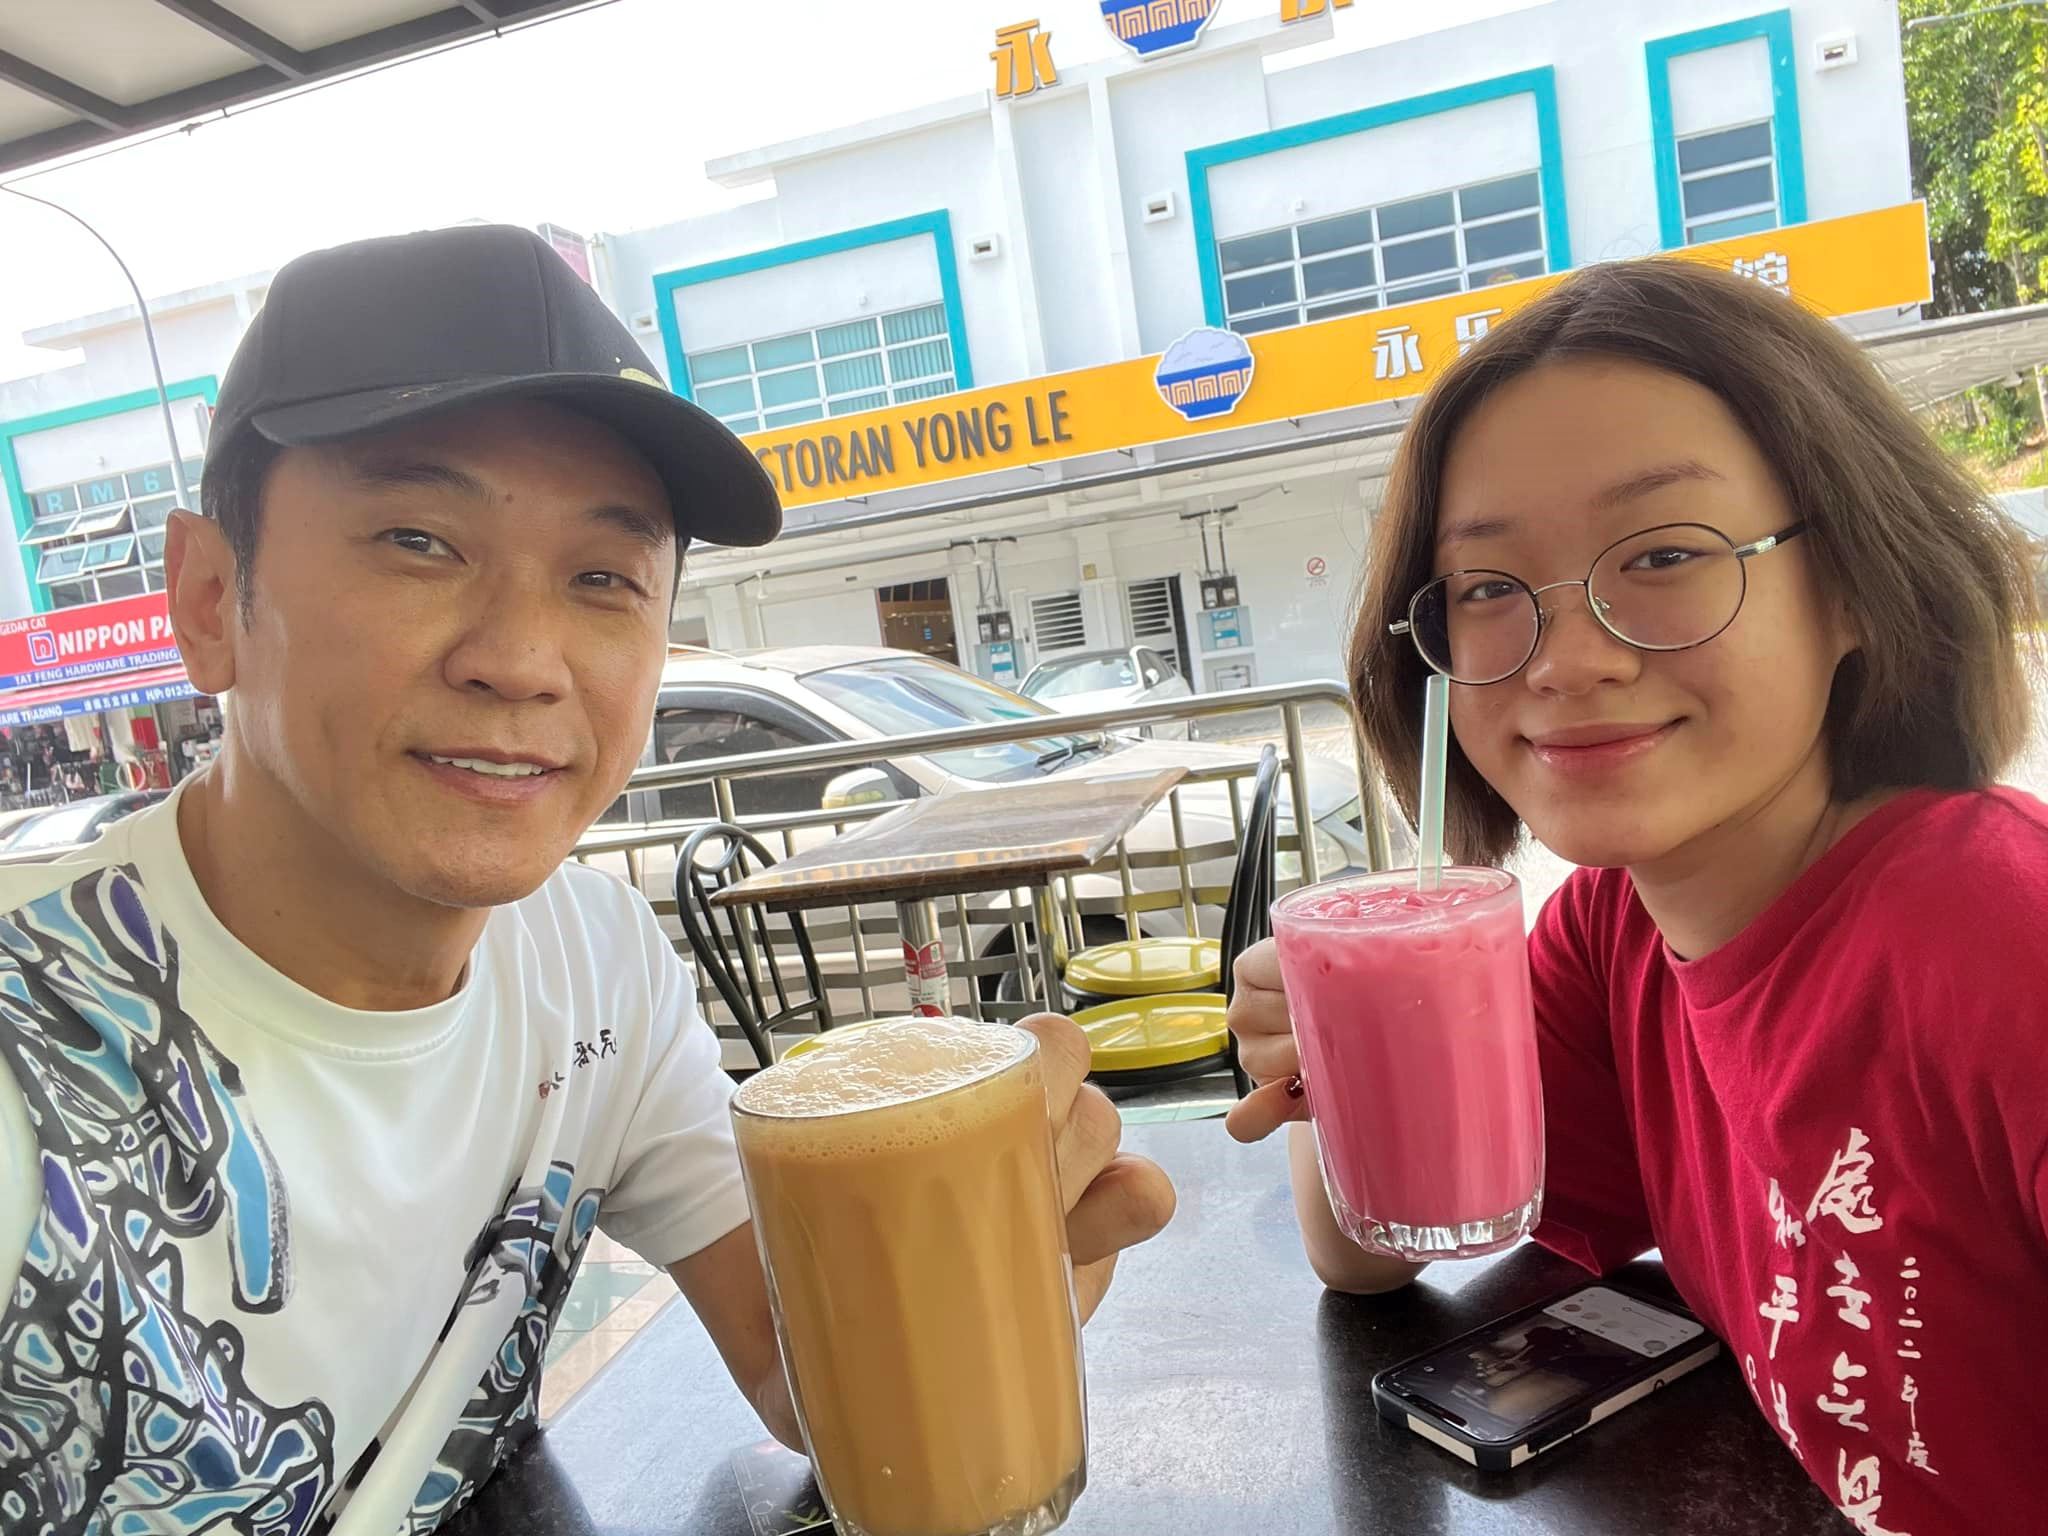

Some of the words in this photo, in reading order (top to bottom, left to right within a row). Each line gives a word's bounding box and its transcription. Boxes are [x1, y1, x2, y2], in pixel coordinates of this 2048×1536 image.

[904, 401, 1013, 468] YONG
[1025, 389, 1073, 447] LE
[58, 618, 145, 656] NIPPON
[14, 673, 34, 686] TAT
[35, 667, 64, 683] FENG
[65, 656, 127, 678] HARDWARE
[128, 647, 178, 667] TRADING
